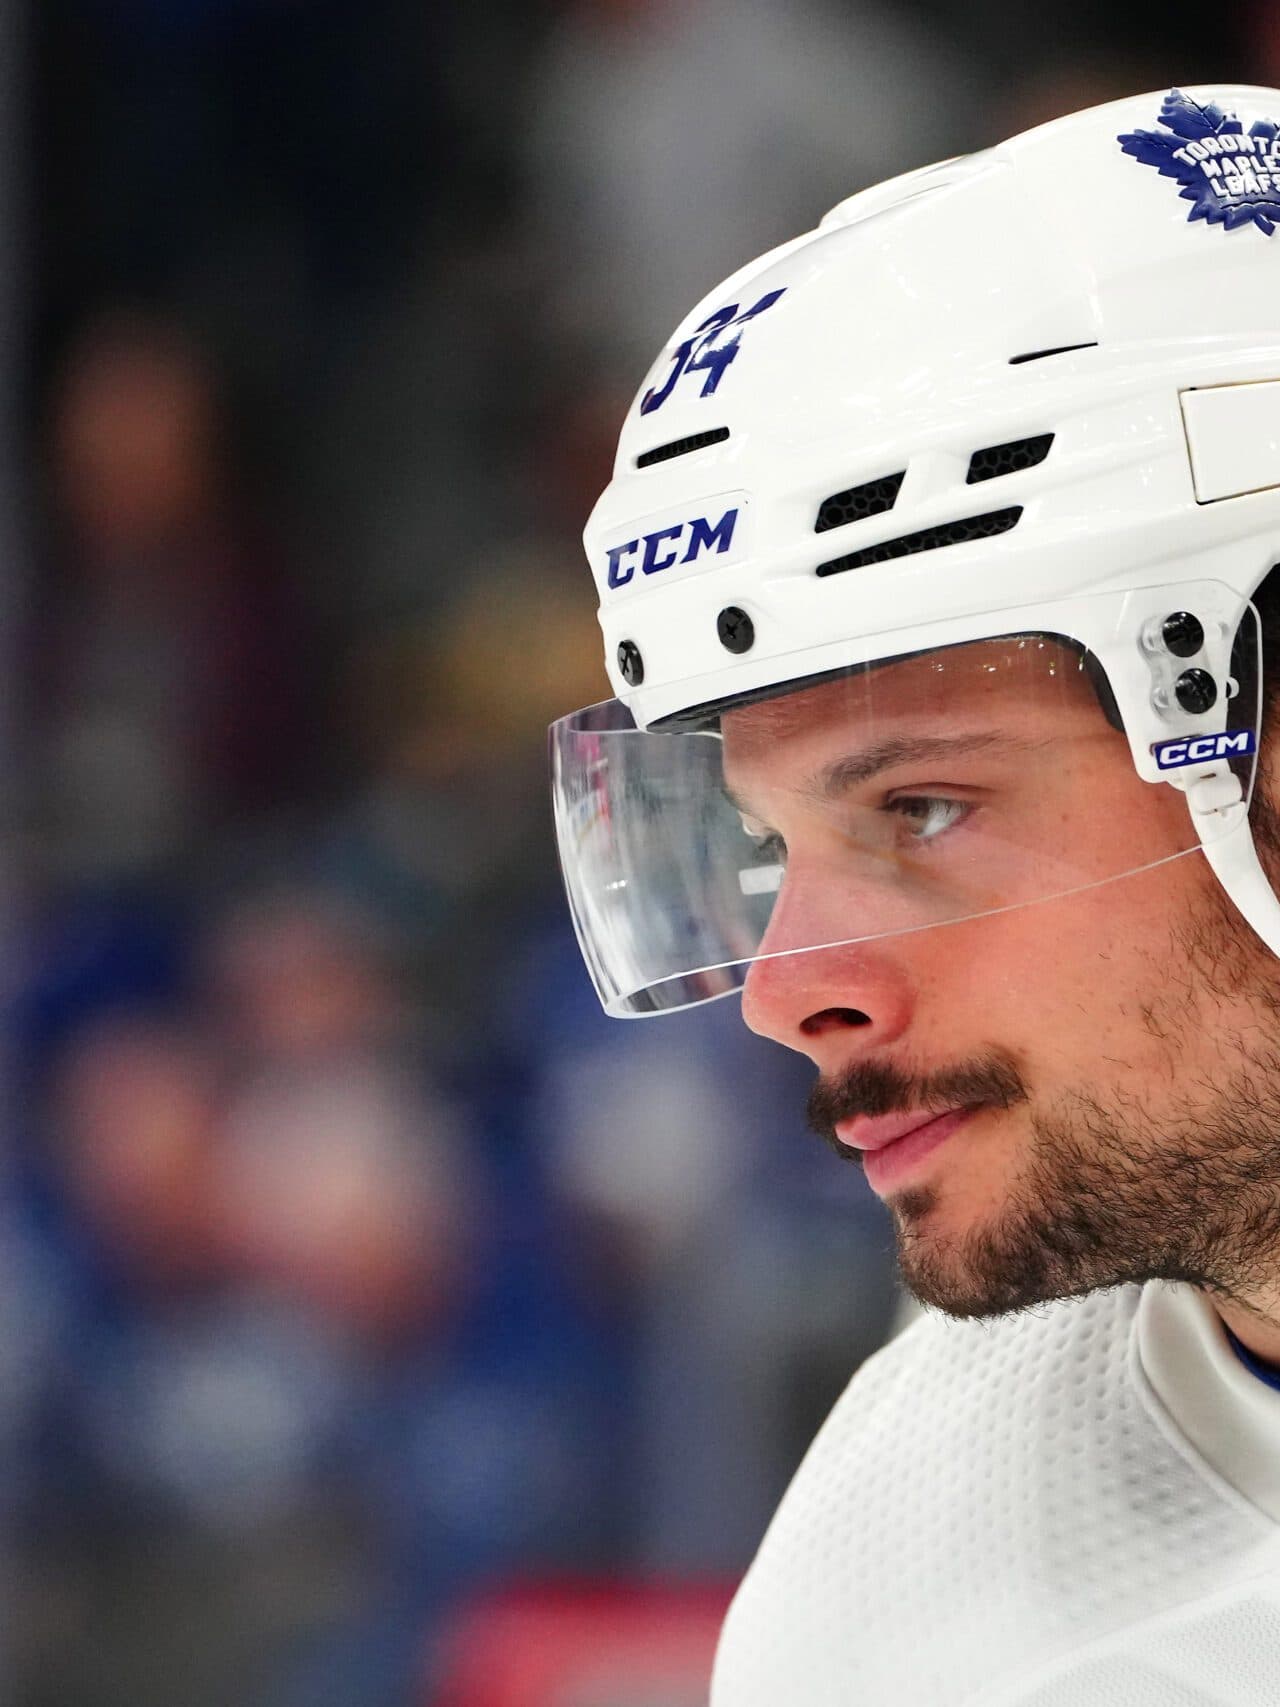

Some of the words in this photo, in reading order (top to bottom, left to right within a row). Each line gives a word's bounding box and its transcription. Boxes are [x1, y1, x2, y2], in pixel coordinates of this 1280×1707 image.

[1201, 155, 1280, 178] MAPLE
[606, 508, 739, 589] CCM
[1159, 732, 1249, 765] CCM
